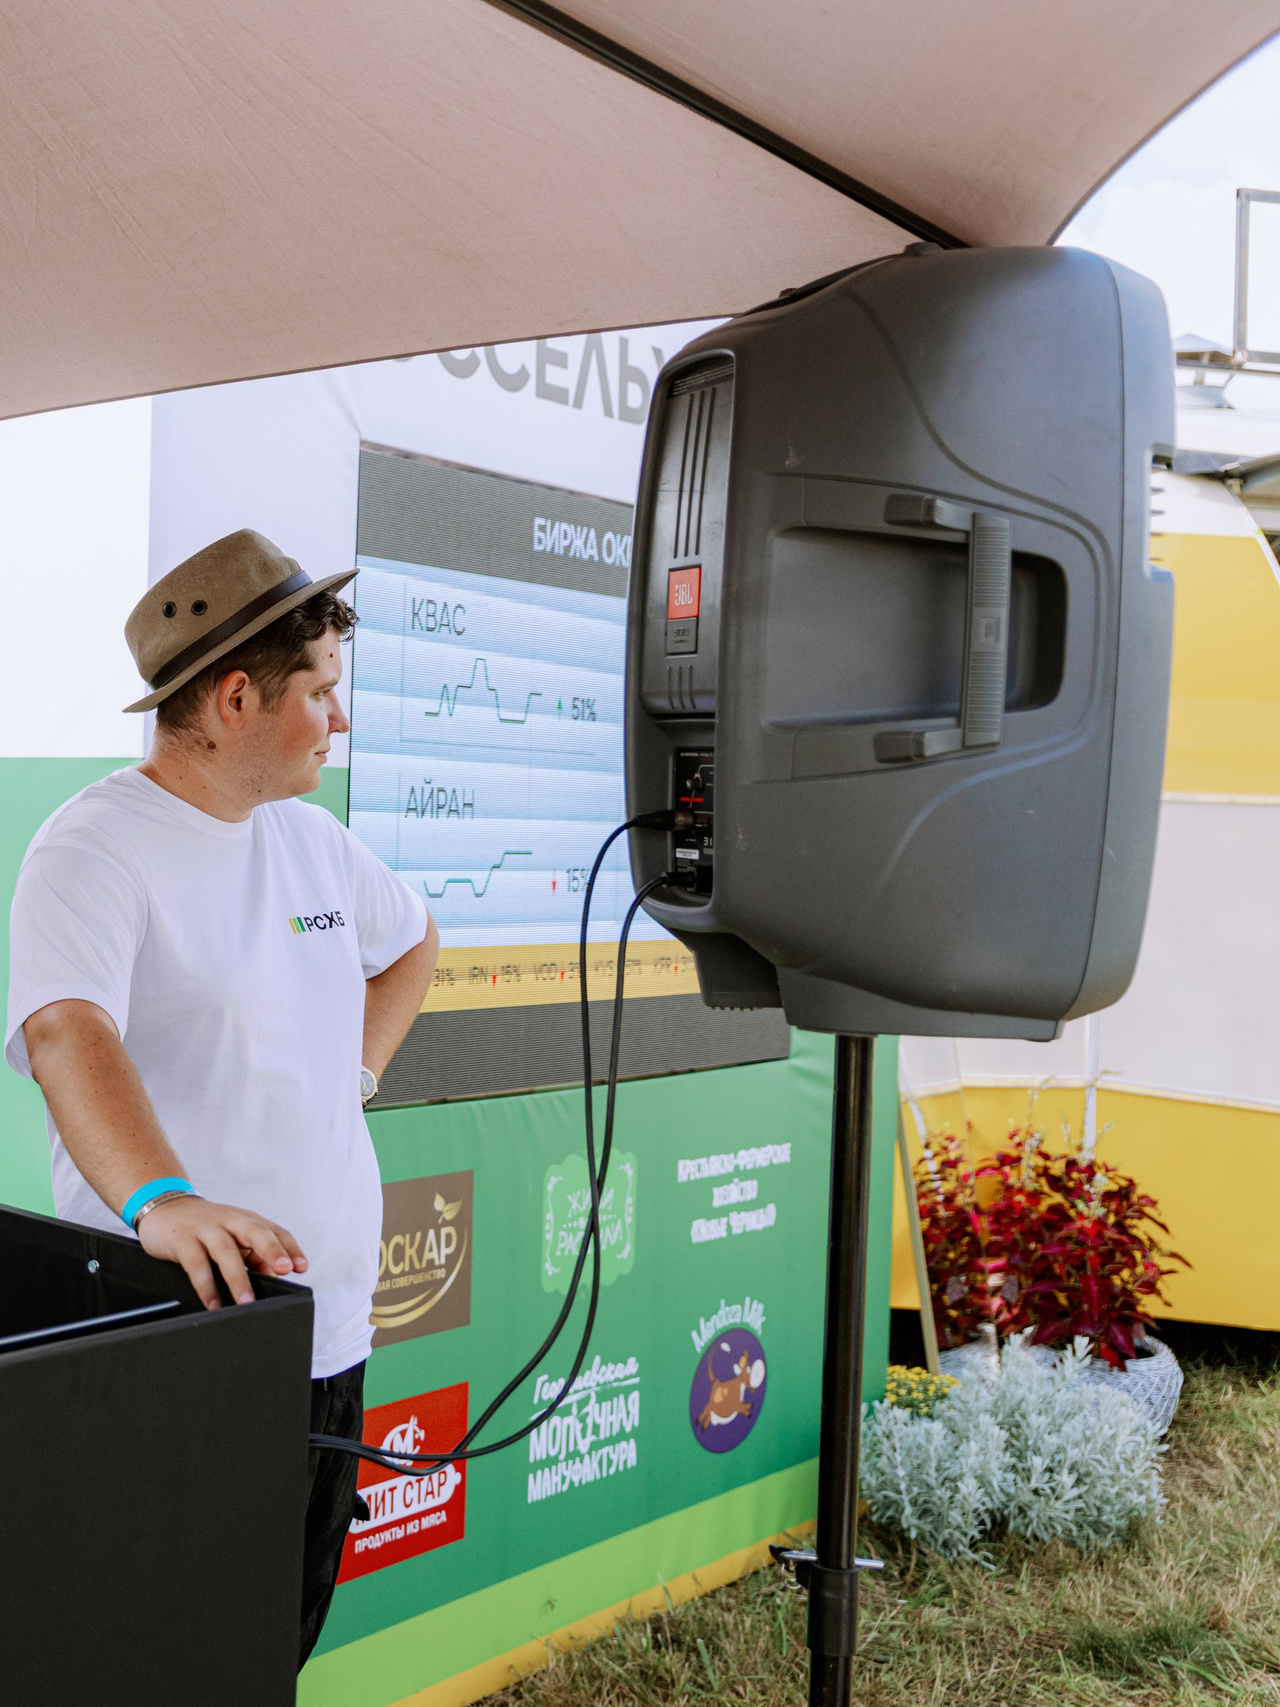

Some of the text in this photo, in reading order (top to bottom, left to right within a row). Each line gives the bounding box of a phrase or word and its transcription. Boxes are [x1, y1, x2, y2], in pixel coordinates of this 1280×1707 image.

[533, 516, 599, 562] БИРЖА
[675, 583, 693, 606] JBL
[411, 597, 466, 635] КВАС
[571, 697, 596, 722] 51%
[405, 777, 475, 820] АЙРАН
[303, 905, 345, 932] РСХБ
[402, 1470, 448, 1509] СТАР
[528, 1438, 637, 1504] МАНУФАКТУРА
[354, 1510, 447, 1554] ПРОДУКТЫ ИЗ МЯСА
